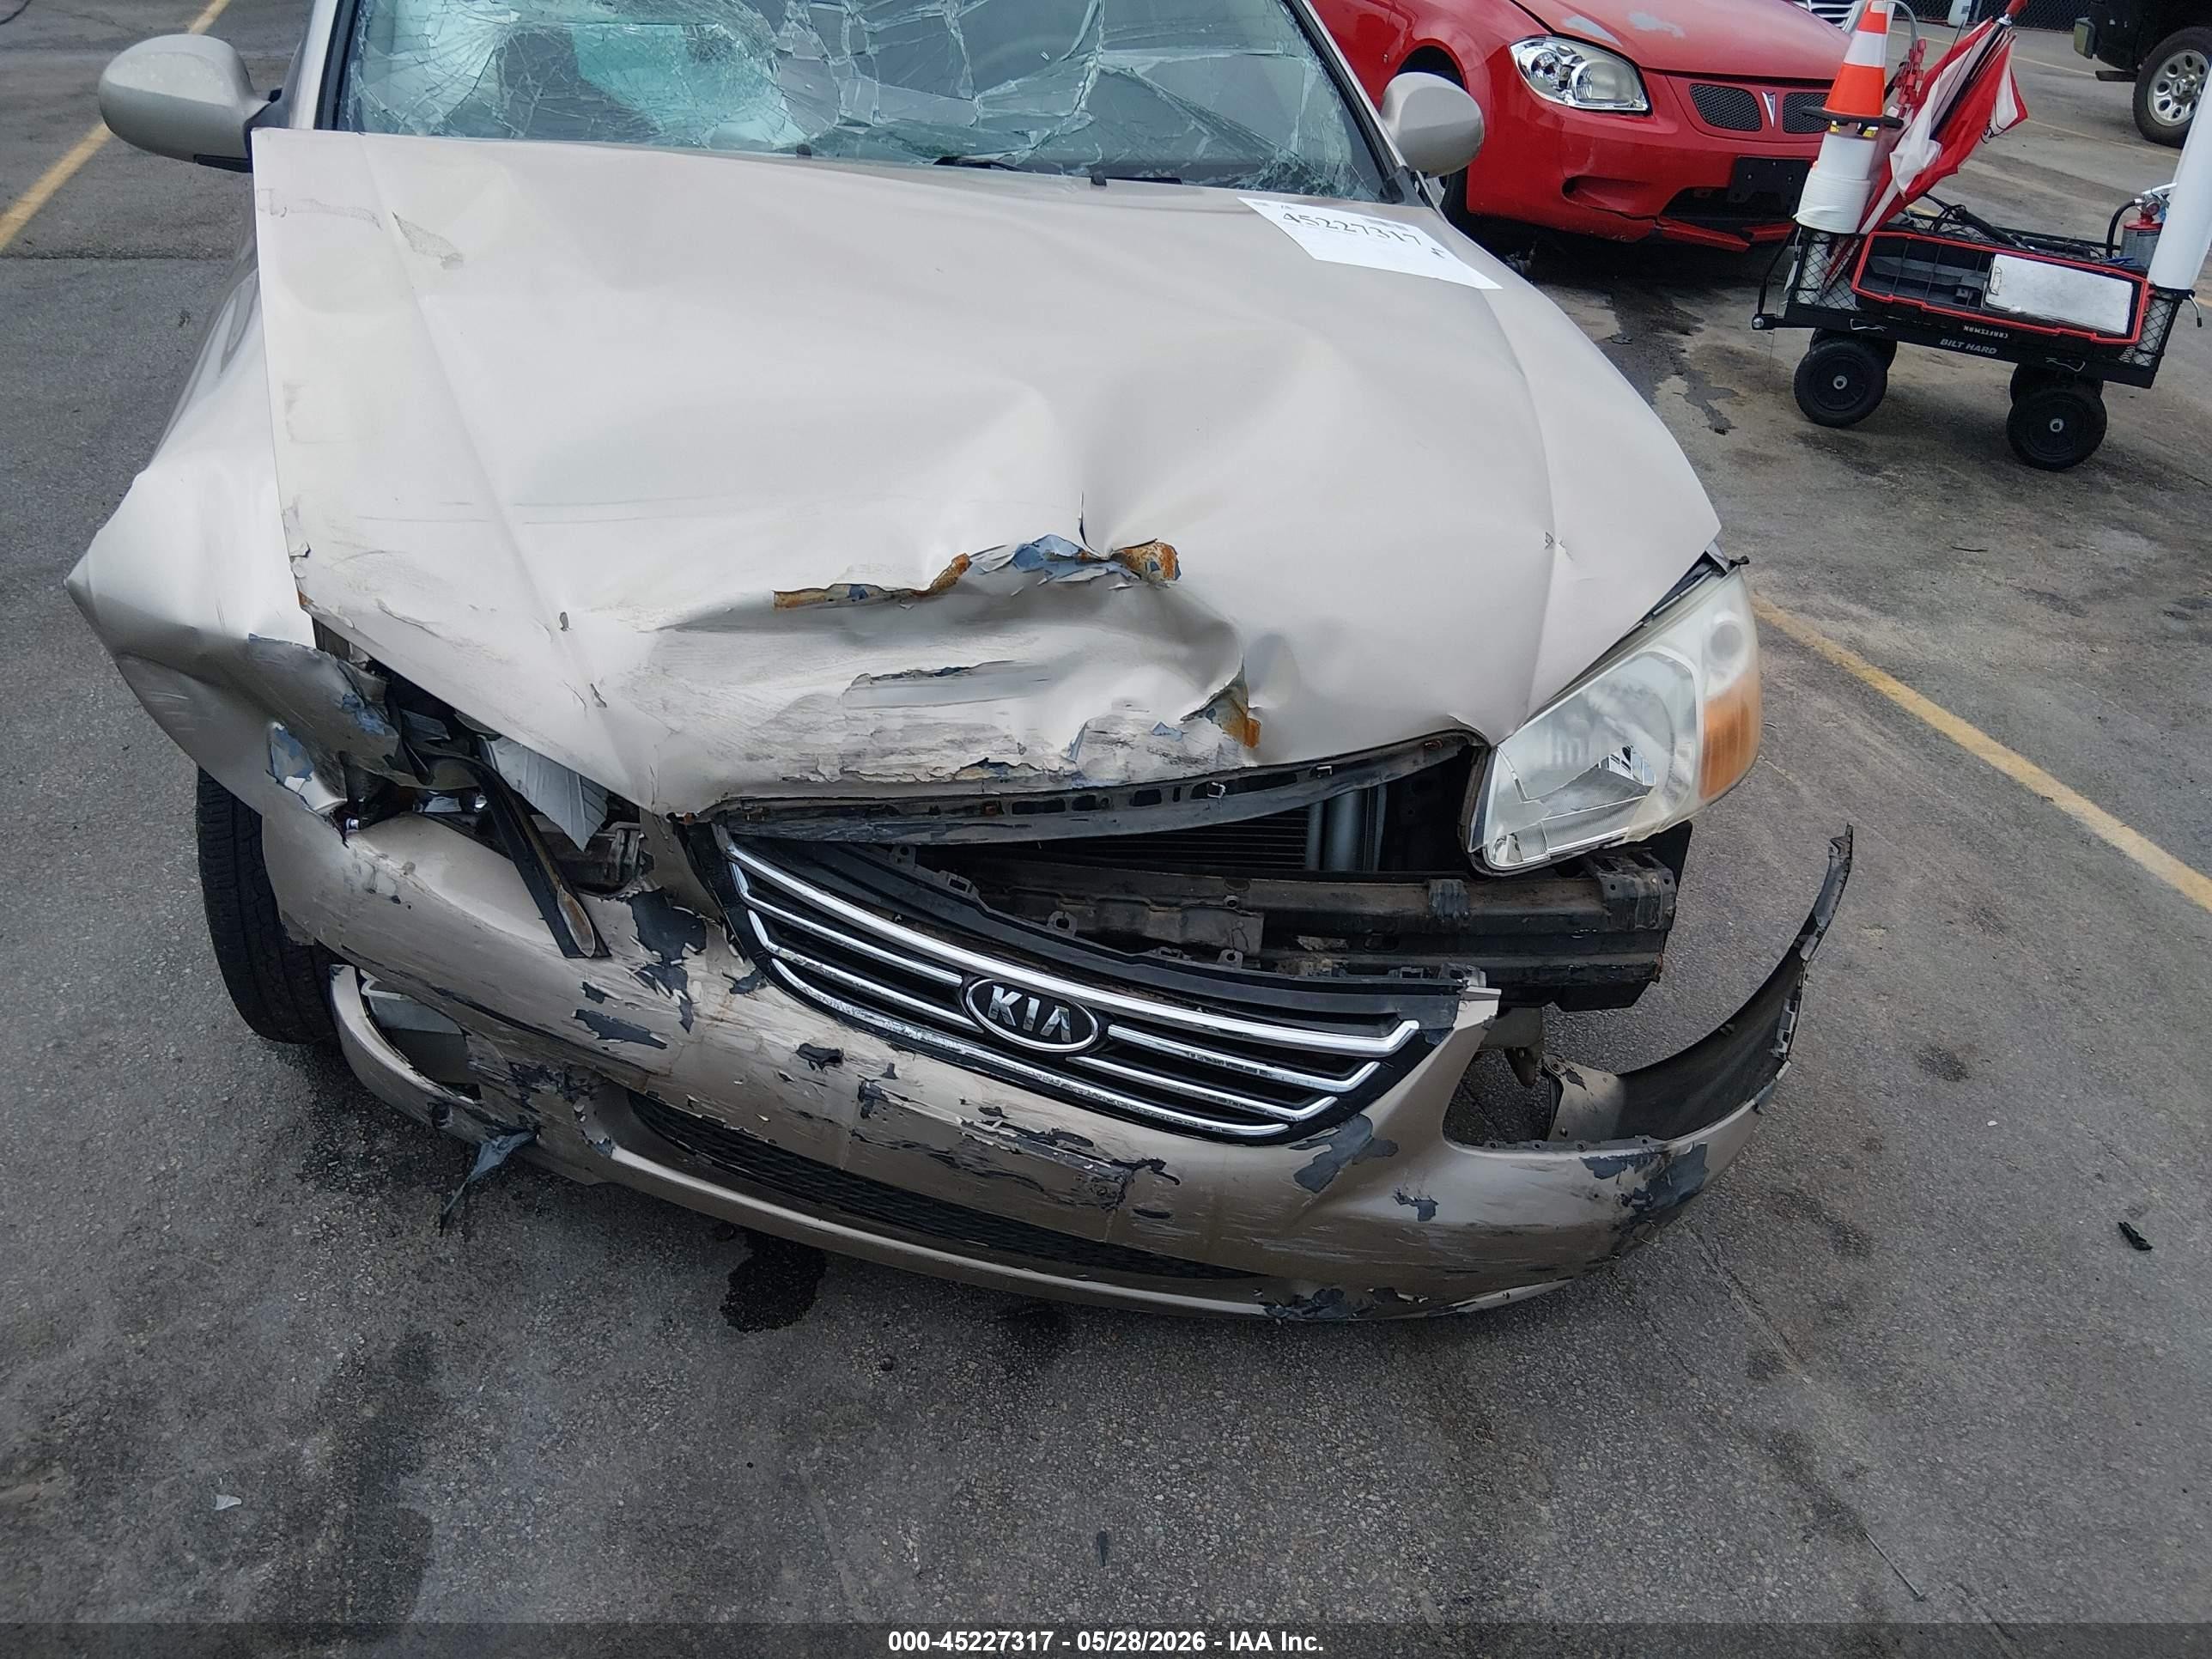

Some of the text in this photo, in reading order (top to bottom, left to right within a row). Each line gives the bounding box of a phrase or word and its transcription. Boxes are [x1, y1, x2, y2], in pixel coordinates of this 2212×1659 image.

[1283, 212, 1422, 246] 45227317
[1963, 325, 2008, 339] CRAFTSMAN
[1939, 338, 1998, 355] BILT HARD
[988, 985, 1073, 1043] KIA
